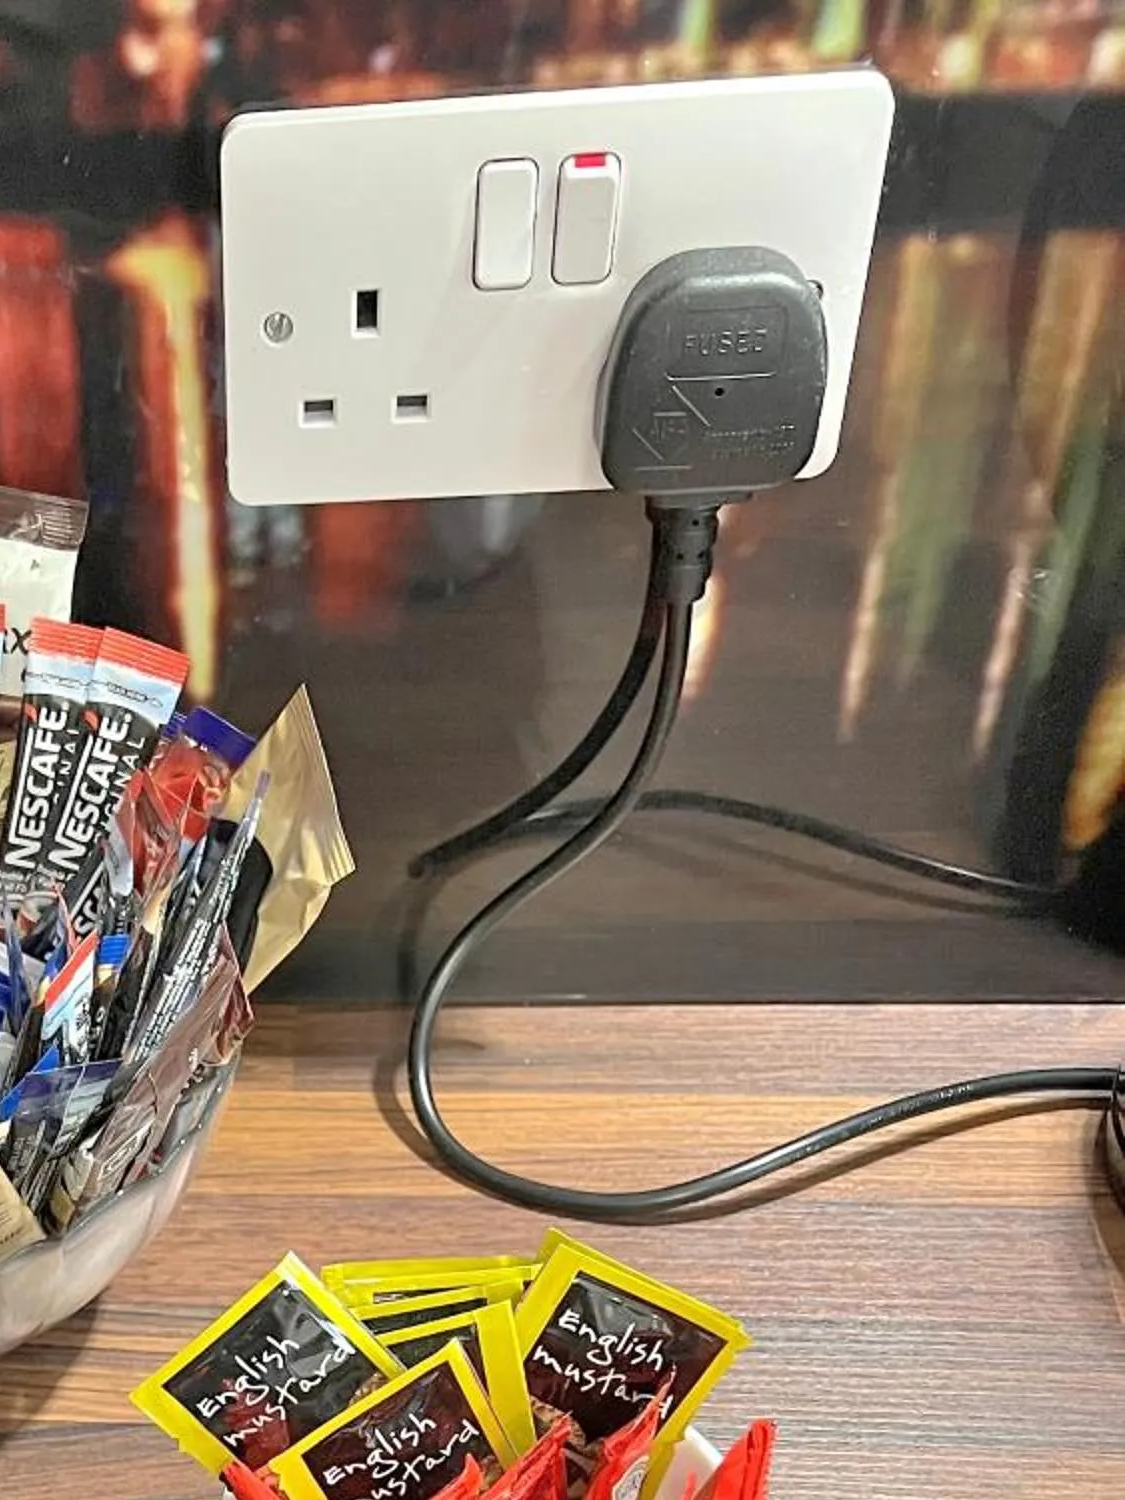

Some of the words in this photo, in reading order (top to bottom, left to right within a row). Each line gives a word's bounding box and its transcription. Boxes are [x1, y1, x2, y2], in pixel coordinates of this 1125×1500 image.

[195, 1335, 300, 1420] English
[559, 1308, 664, 1372] English
[223, 1334, 356, 1448] mustard
[323, 1413, 437, 1487] English
